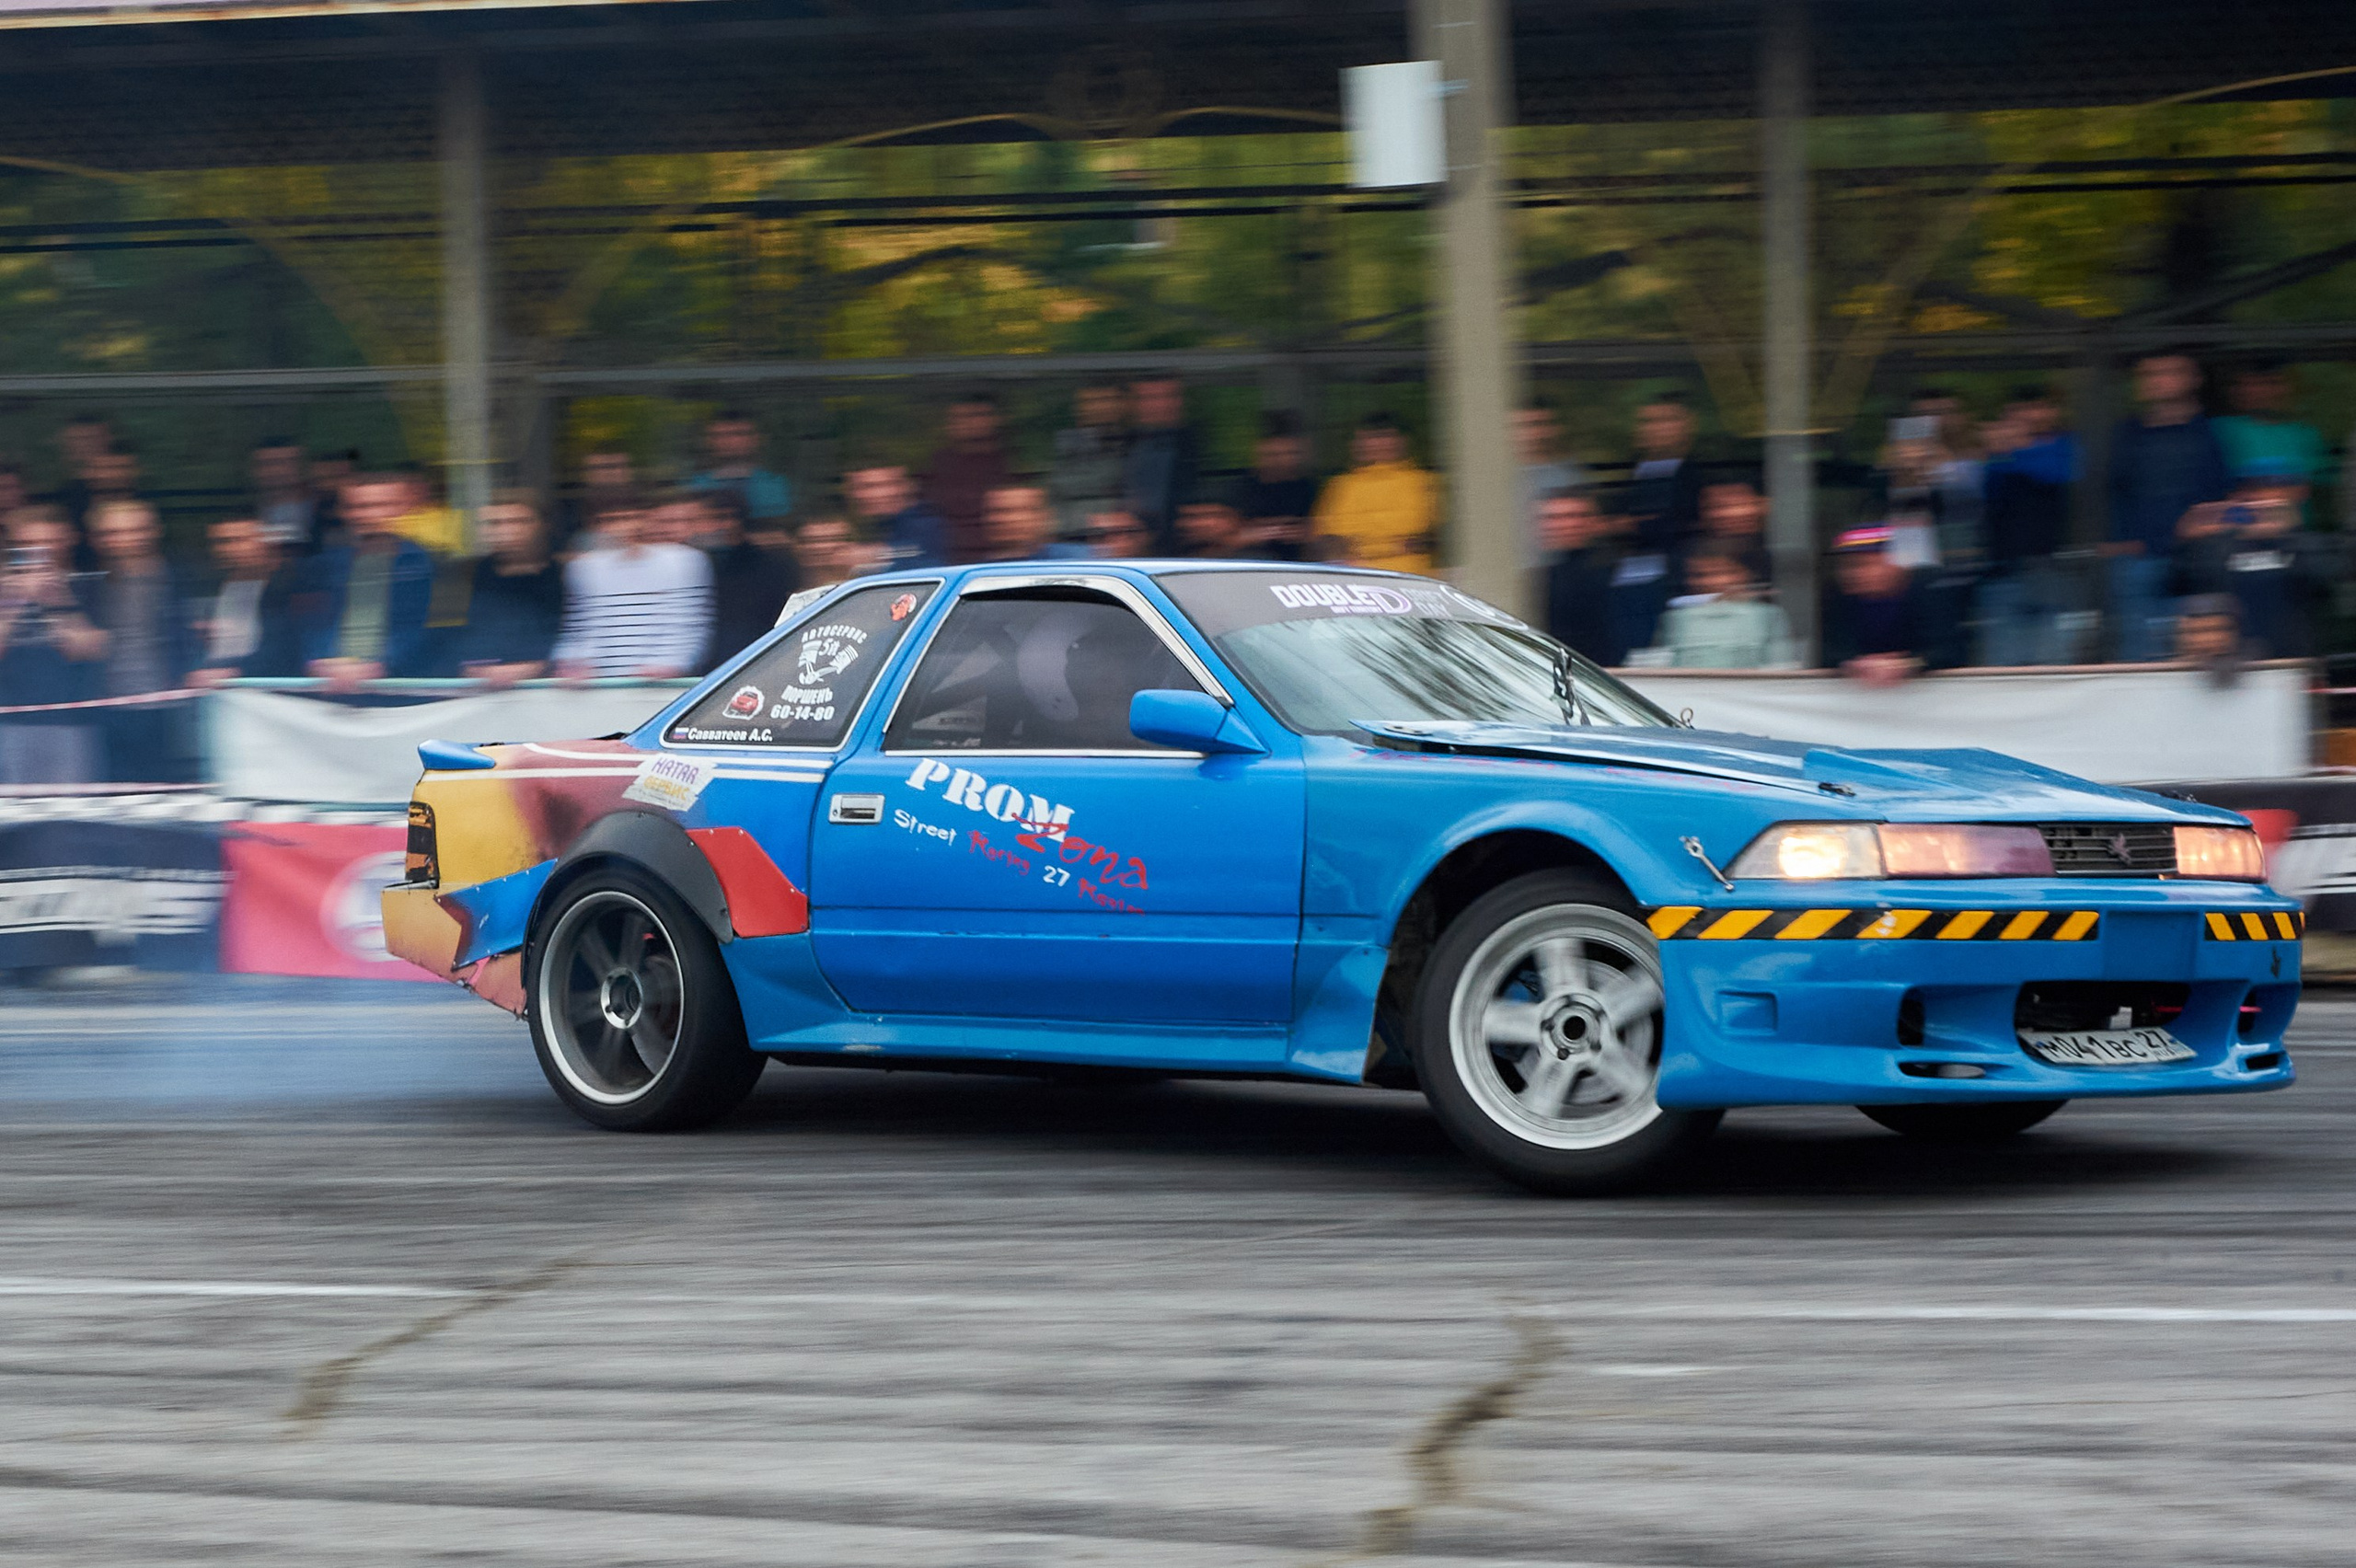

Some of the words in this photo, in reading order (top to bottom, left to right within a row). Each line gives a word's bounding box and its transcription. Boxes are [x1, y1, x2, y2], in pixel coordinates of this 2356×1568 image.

[1269, 583, 1376, 607] DOUBLE
[802, 625, 867, 644] АВТОСЕРВИС
[780, 685, 834, 705] ПОРШЕНЬ
[770, 704, 836, 721] 60-14-80
[906, 757, 1075, 843] PROM
[894, 808, 958, 847] Street
[1043, 865, 1071, 887] 27
[2134, 1030, 2169, 1048] 27
